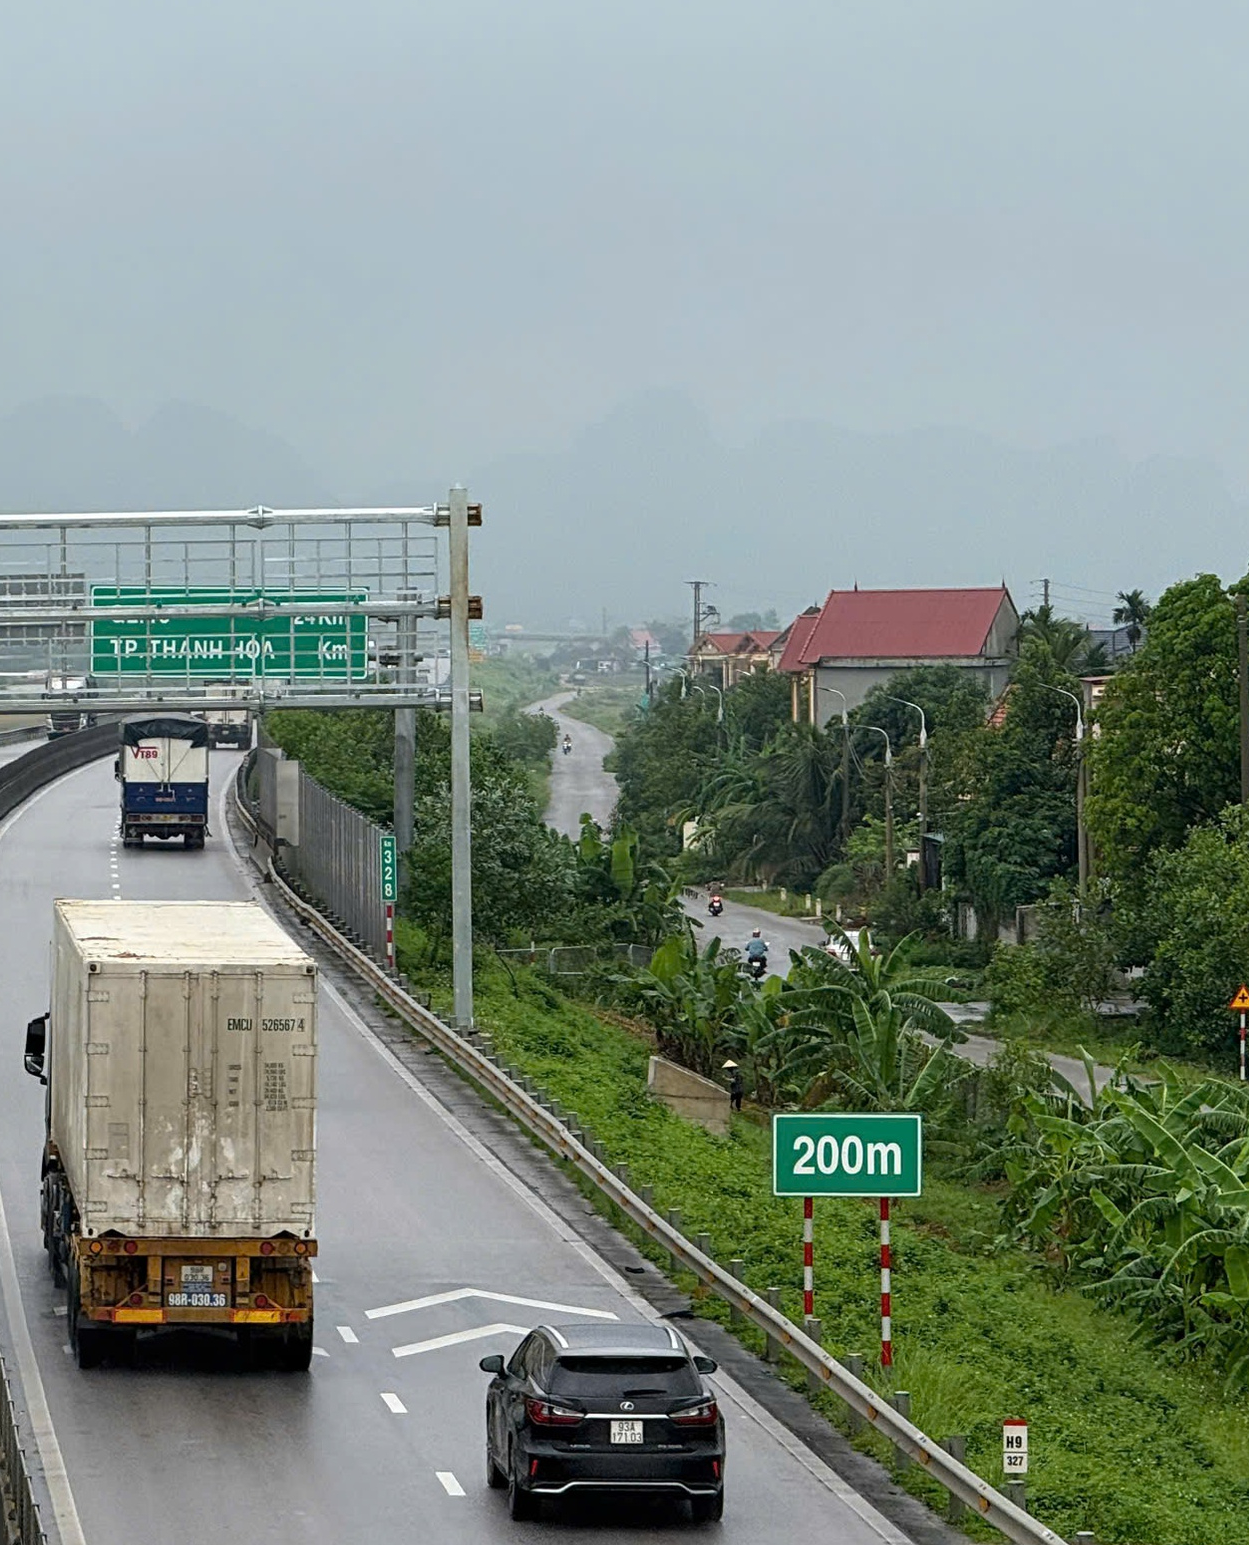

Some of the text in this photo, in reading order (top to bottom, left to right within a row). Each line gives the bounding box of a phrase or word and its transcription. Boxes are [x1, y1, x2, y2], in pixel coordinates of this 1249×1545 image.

[150, 639, 223, 659] THANH
[318, 641, 349, 660] Km
[384, 850, 393, 897] 328
[227, 1018, 306, 1032] EMCU 526567 4
[793, 1135, 902, 1175] 200m
[168, 1293, 226, 1307] 98R-030.36
[618, 1421, 636, 1432] 93A
[1006, 1435, 1022, 1448] H9
[1007, 1456, 1023, 1466] 327
